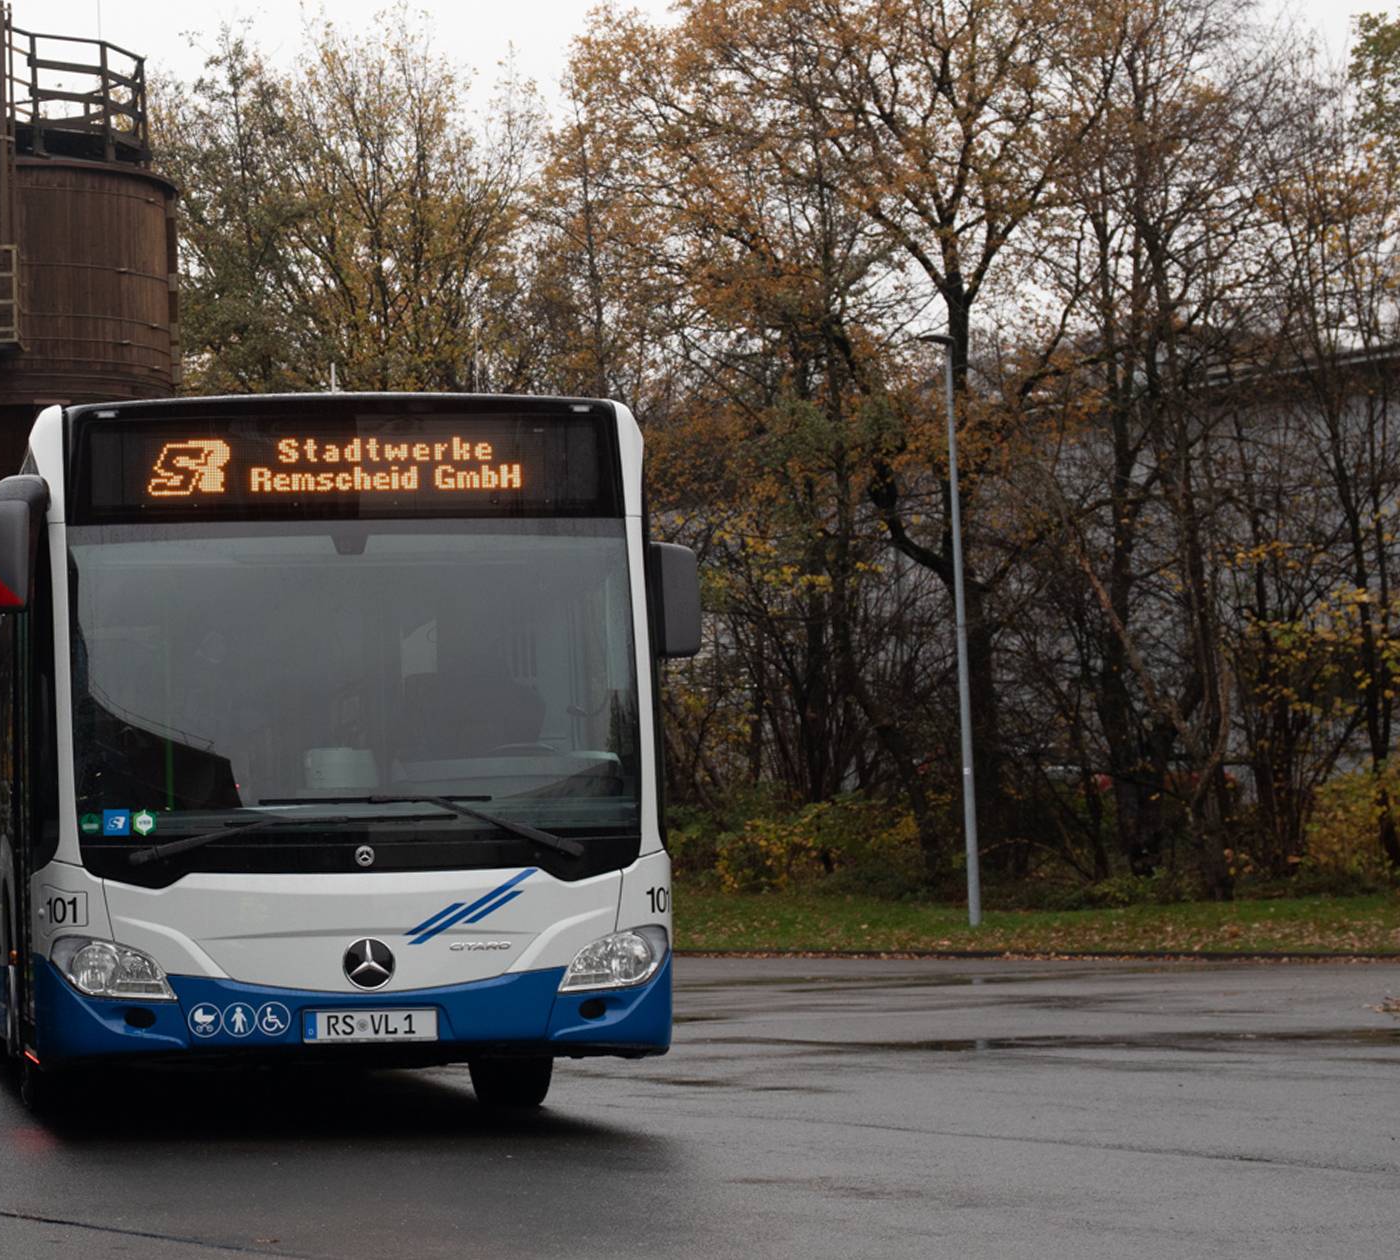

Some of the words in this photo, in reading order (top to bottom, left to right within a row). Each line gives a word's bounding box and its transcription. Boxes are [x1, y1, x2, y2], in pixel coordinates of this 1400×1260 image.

[279, 437, 493, 462] Stadtwerke
[250, 466, 419, 491] Remscheid
[434, 464, 521, 489] GmbH
[46, 896, 78, 923] 101
[449, 941, 512, 952] CITARO
[327, 1015, 355, 1036] RS
[370, 1014, 398, 1034] VL
[403, 1014, 416, 1034] 1
